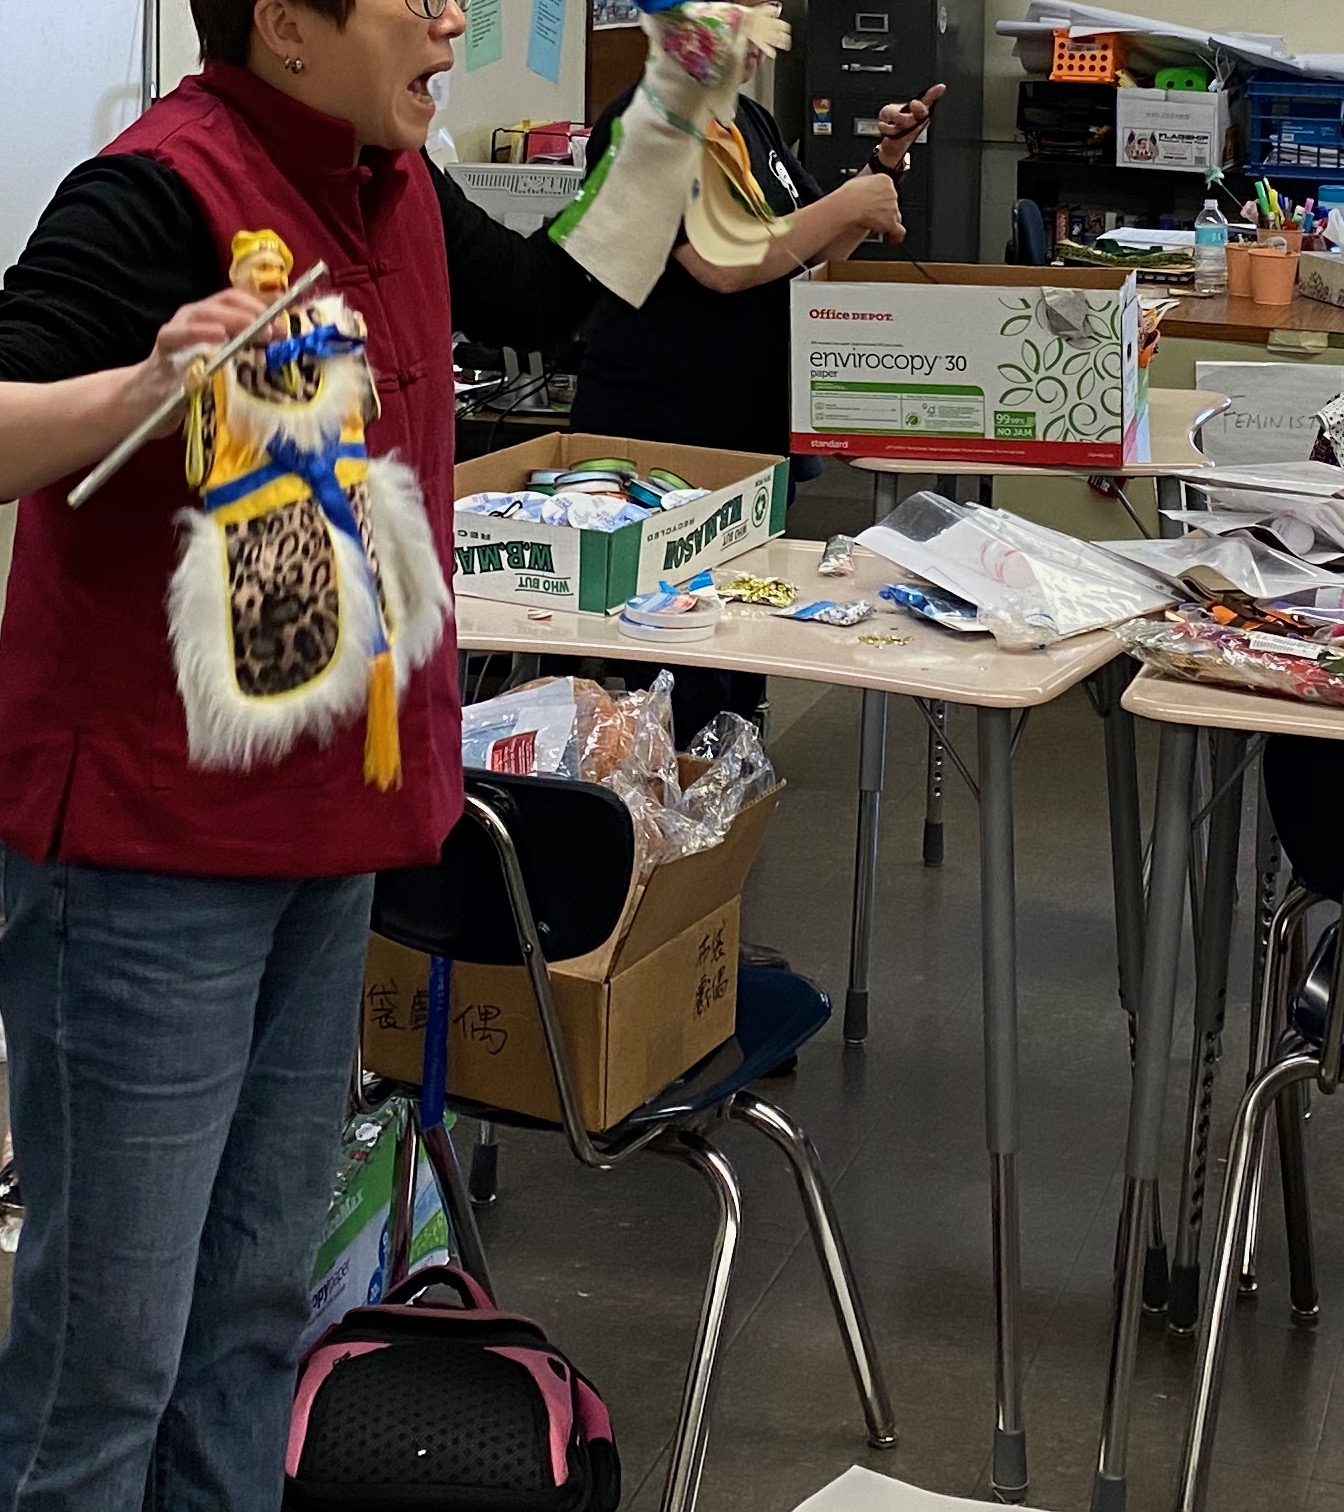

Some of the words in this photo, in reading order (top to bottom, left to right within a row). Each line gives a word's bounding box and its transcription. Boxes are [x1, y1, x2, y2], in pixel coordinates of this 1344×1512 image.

[809, 308, 850, 320] Office
[809, 347, 939, 376] envirocopy
[945, 355, 968, 372] 30
[810, 370, 838, 379] paper
[997, 428, 1012, 436] NO
[1013, 428, 1033, 437] JAM
[811, 439, 849, 449] standard
[646, 517, 695, 542] RECYCLED
[453, 541, 555, 575] W.B.MA
[518, 575, 541, 590] BUT
[543, 579, 570, 593] WHO
